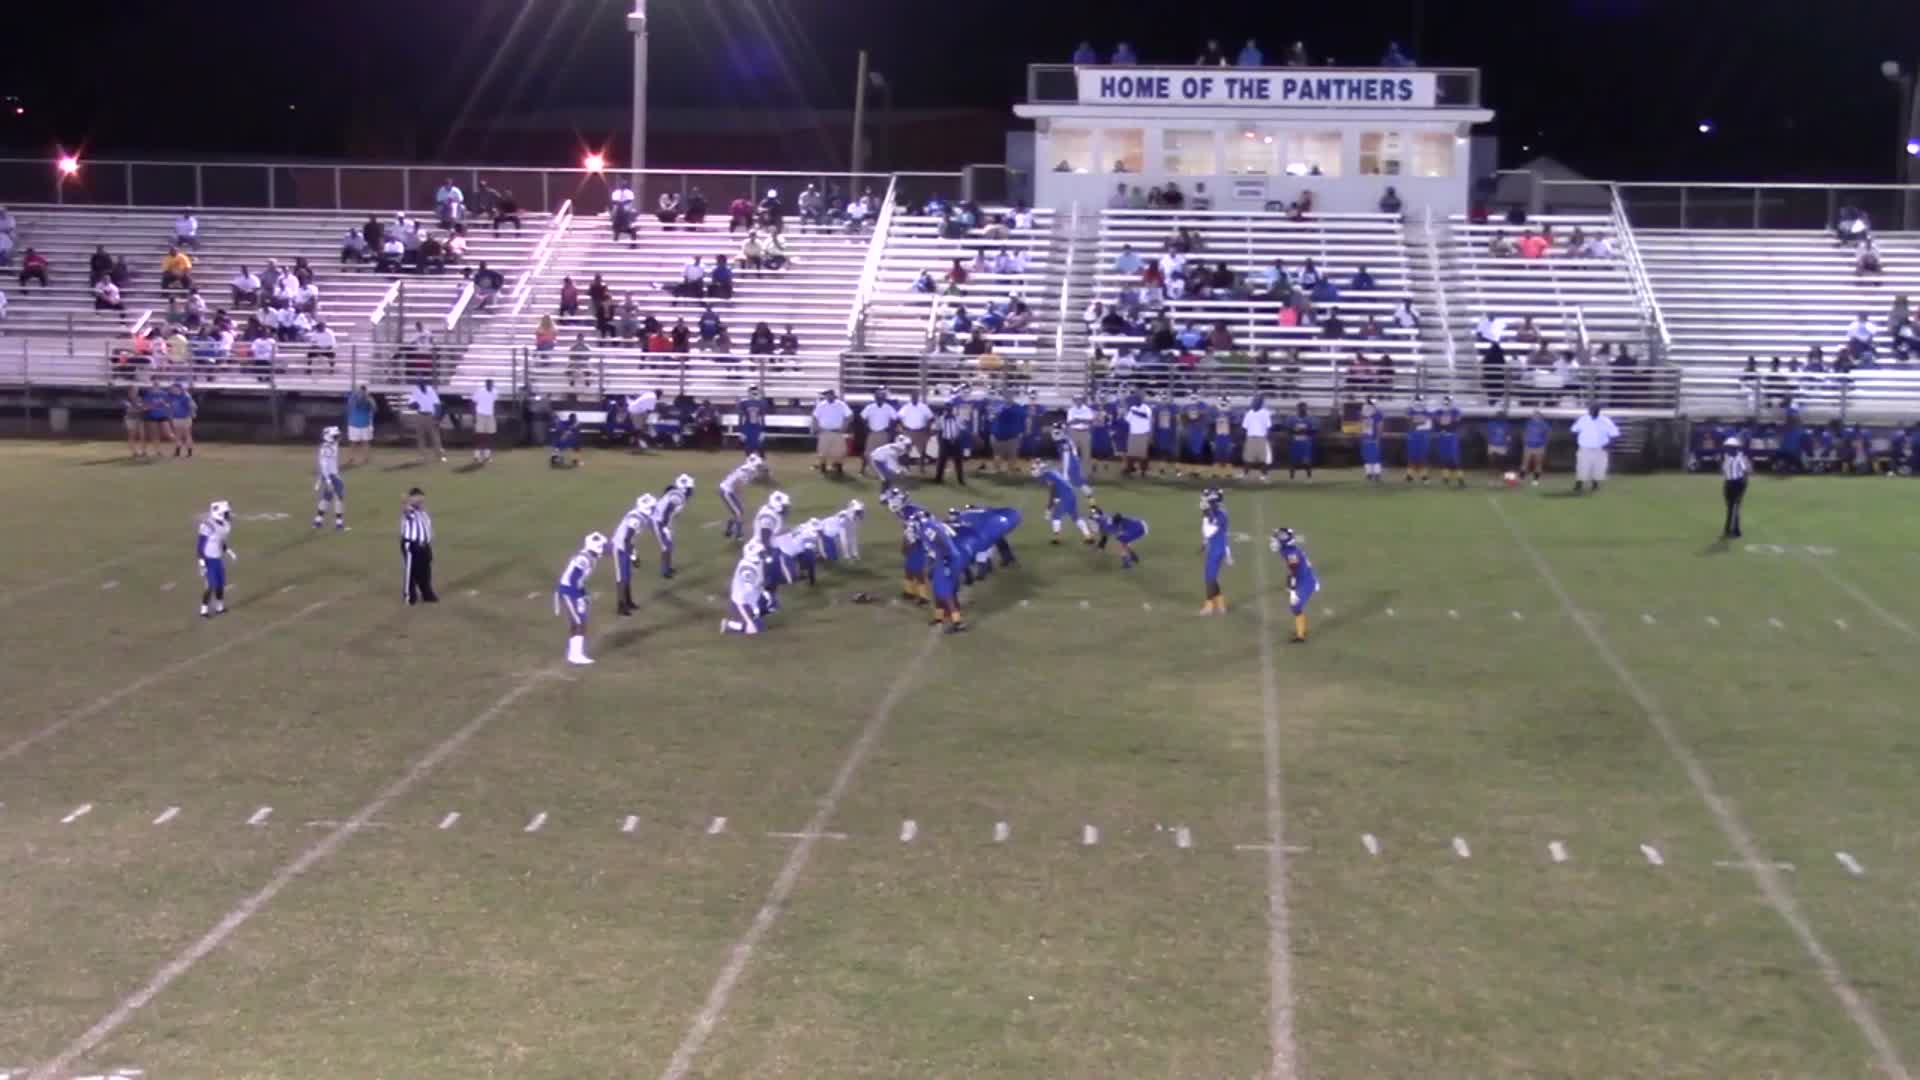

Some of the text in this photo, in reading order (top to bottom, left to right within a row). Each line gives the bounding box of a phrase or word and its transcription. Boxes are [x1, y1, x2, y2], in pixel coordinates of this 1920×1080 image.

[1101, 76, 1414, 101] HOME OF THE PANTHERS
